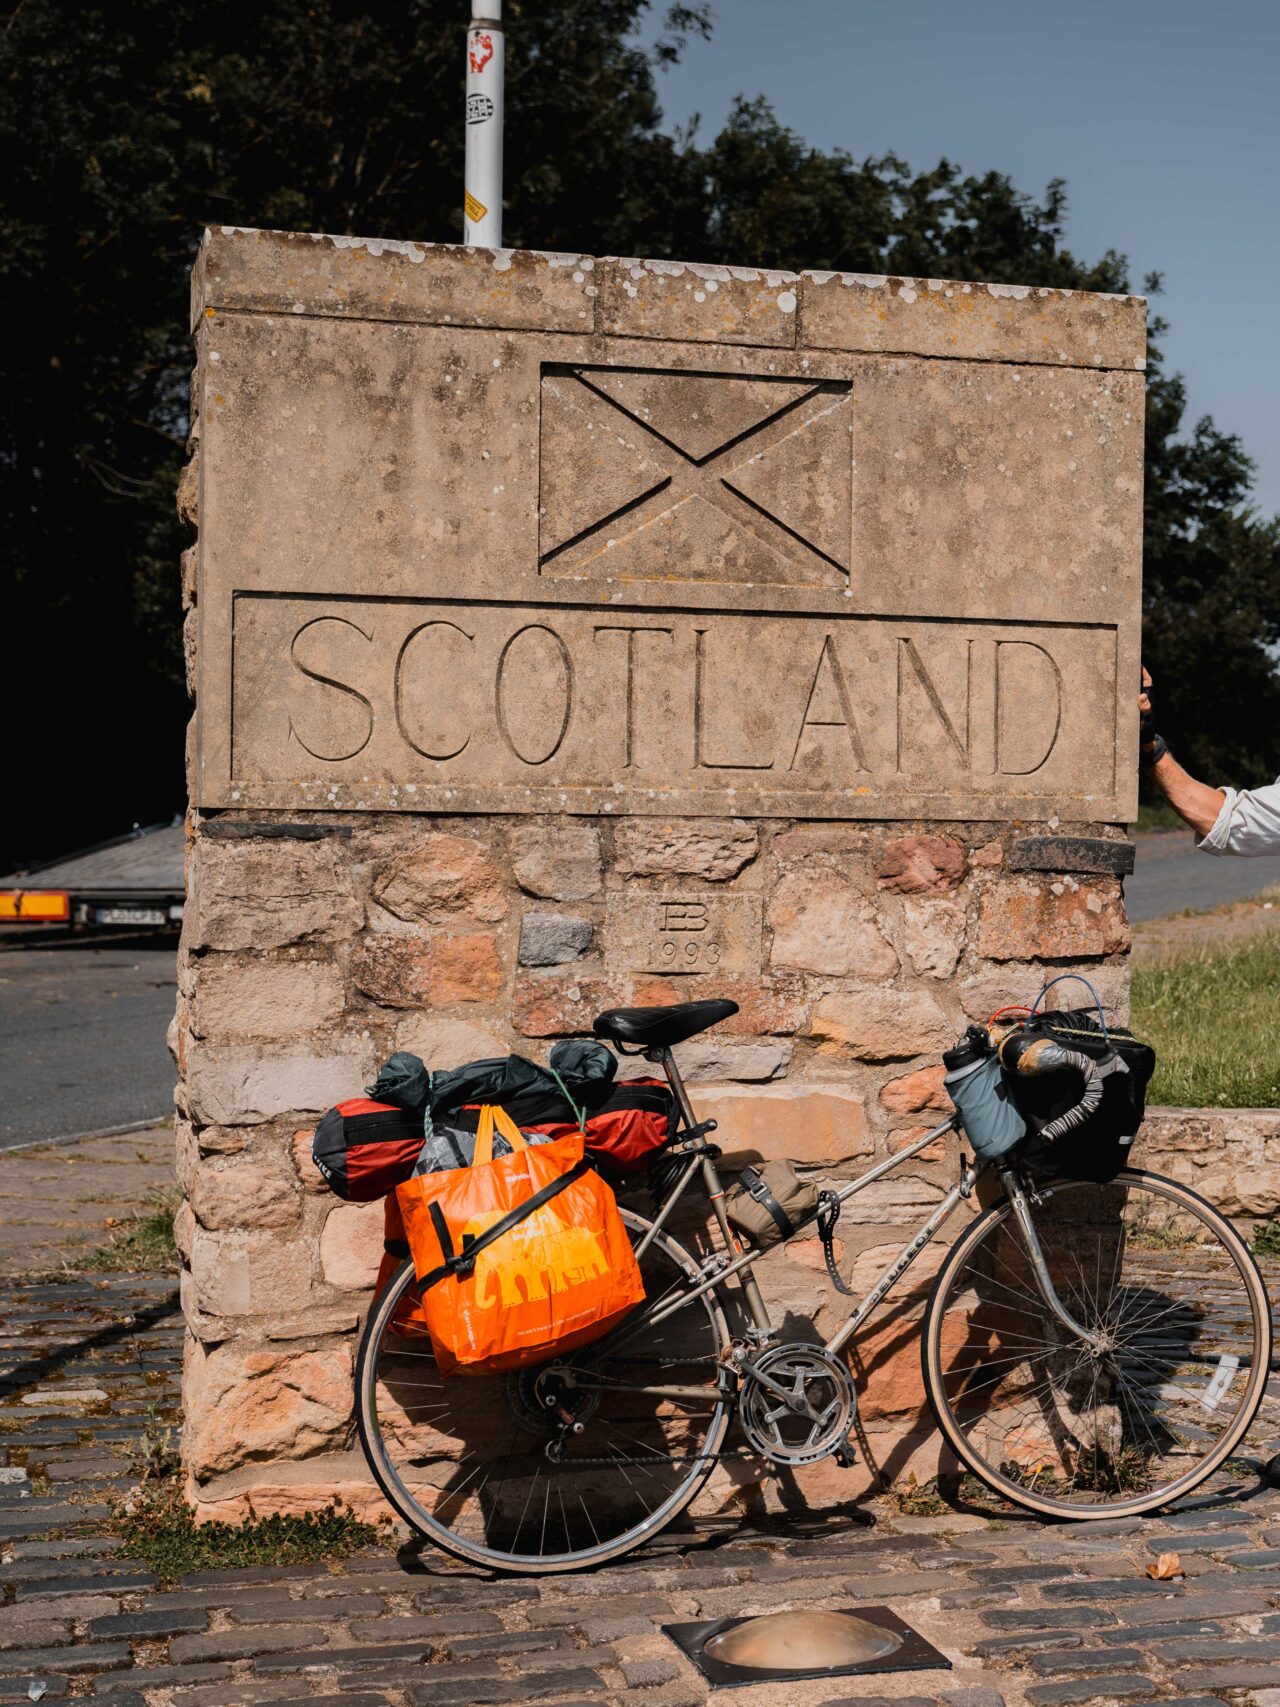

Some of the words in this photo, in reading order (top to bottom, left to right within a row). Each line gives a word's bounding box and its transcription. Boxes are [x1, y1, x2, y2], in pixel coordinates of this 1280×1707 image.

[287, 614, 1064, 775] SCOTLAND
[647, 941, 722, 966] 1993
[869, 1225, 935, 1304] PEUGEOT
